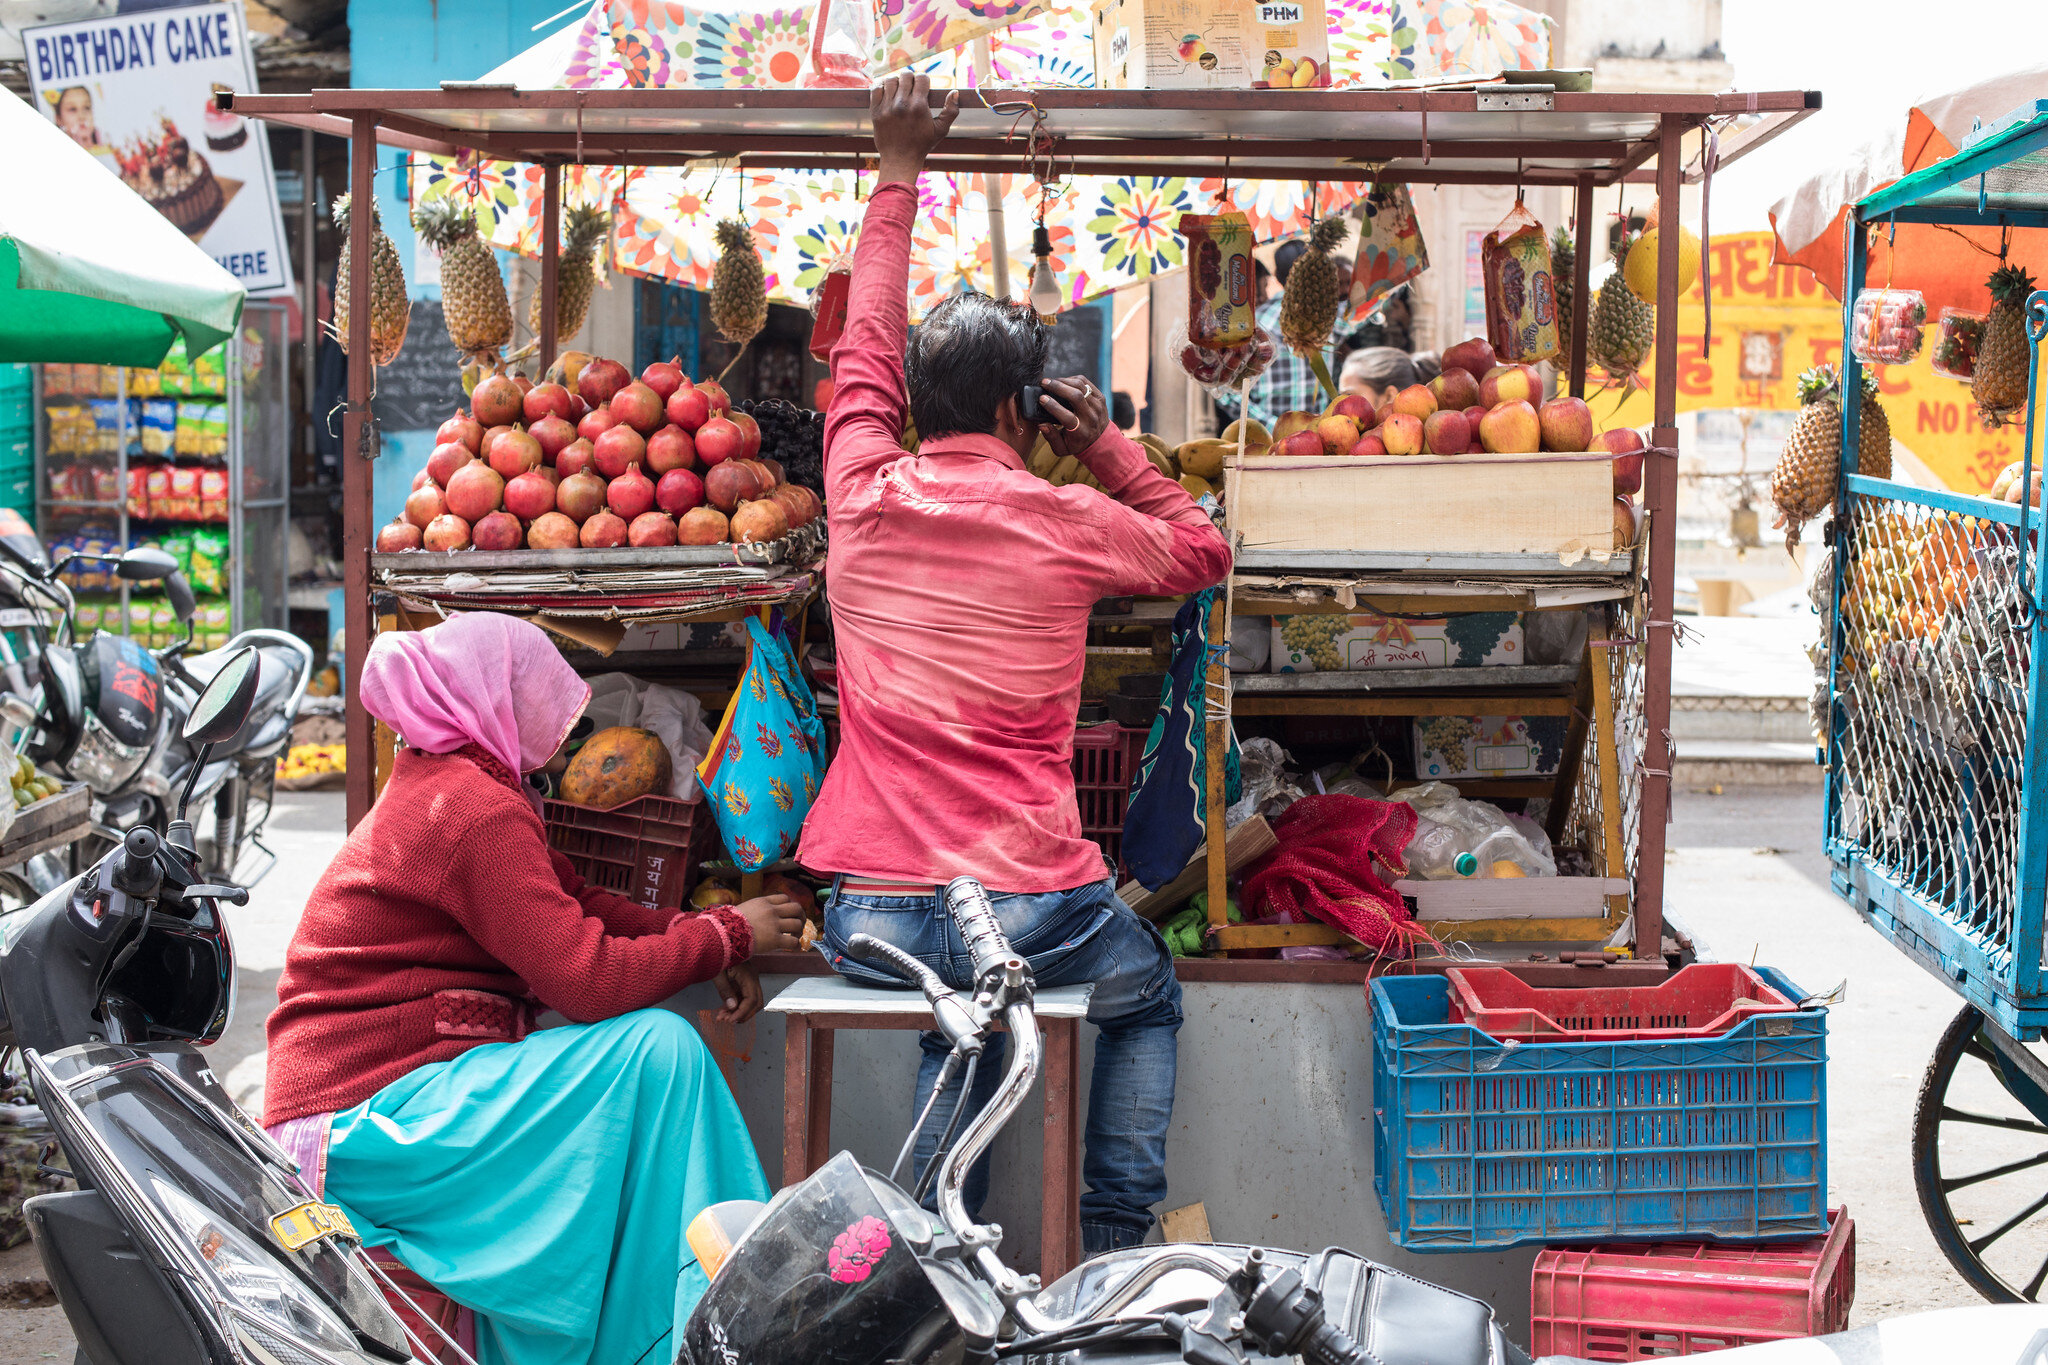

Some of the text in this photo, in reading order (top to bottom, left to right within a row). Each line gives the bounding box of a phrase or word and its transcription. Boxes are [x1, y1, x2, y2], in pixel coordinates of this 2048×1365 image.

[1262, 6, 1299, 21] PHM
[36, 12, 232, 81] BIRTHDAY CAKE
[1112, 31, 1128, 62] PHM
[215, 251, 268, 278] HERE
[1222, 303, 1233, 333] Dates
[1529, 322, 1539, 354] Dates
[1917, 399, 1959, 434] NO
[1303, 724, 1397, 741] PREMIM
